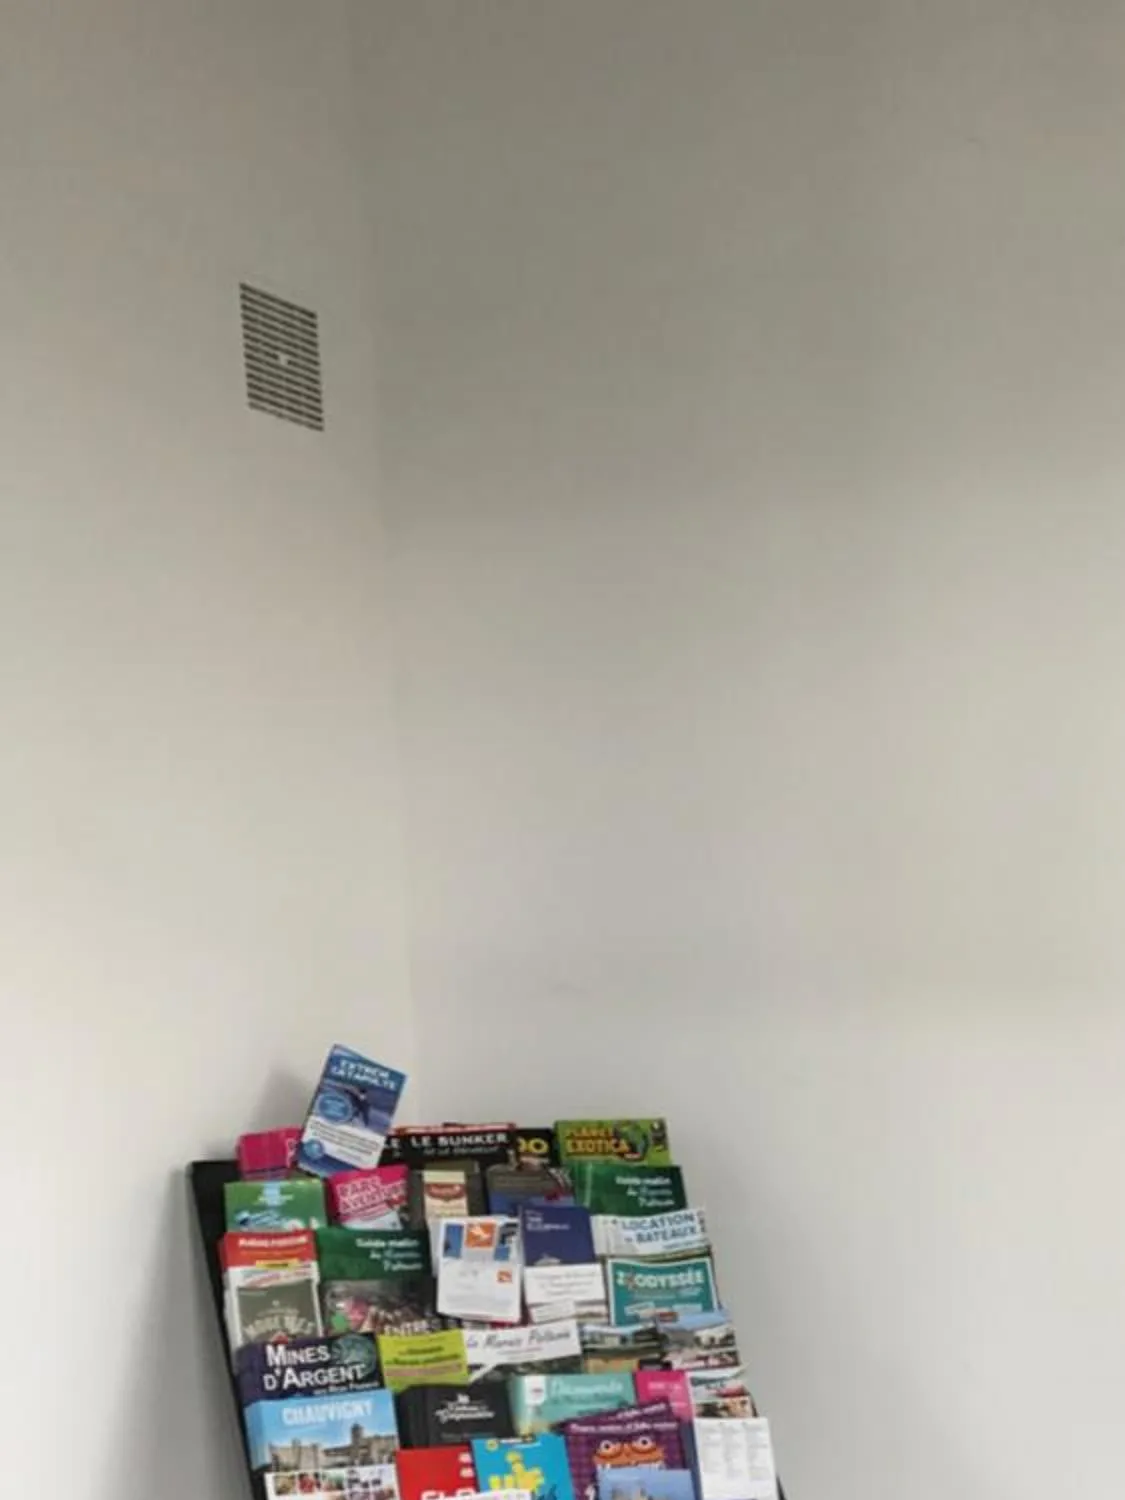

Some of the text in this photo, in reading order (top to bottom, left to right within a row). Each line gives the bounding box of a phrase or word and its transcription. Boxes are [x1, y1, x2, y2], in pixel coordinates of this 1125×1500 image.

[411, 1133, 510, 1147] LE BUNKER
[566, 1138, 631, 1154] EXOTICA
[621, 1211, 696, 1231] LOCATION
[635, 1225, 698, 1244] BATEAUX
[265, 1343, 331, 1367] MINES
[262, 1363, 367, 1391] D'ARGENT
[281, 1400, 374, 1426] CHAUVIGNY
